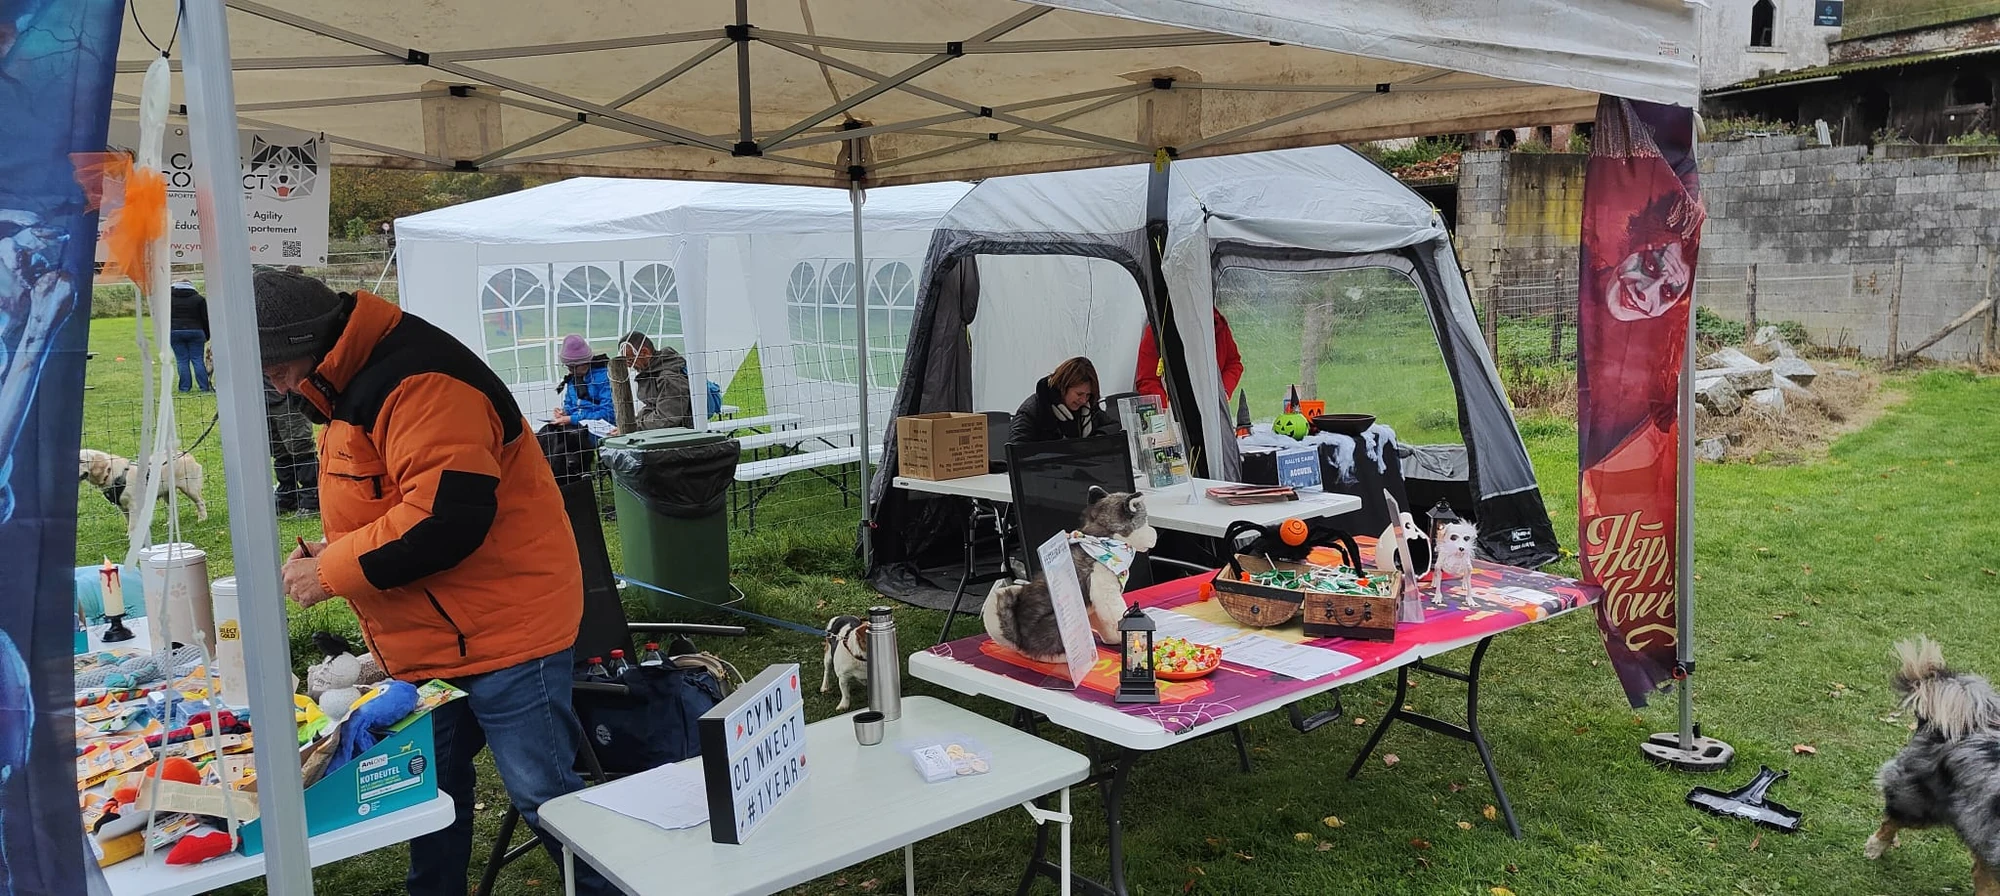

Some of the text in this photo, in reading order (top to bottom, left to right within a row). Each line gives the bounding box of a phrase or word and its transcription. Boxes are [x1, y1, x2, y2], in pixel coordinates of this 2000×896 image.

[253, 211, 283, 222] Agility
[248, 226, 297, 234] portement
[1290, 466, 1312, 477] ACCUEIL
[746, 687, 783, 736] CYNO
[360, 766, 400, 785] KOTBEUTEL
[747, 757, 799, 825] #1YEAR
